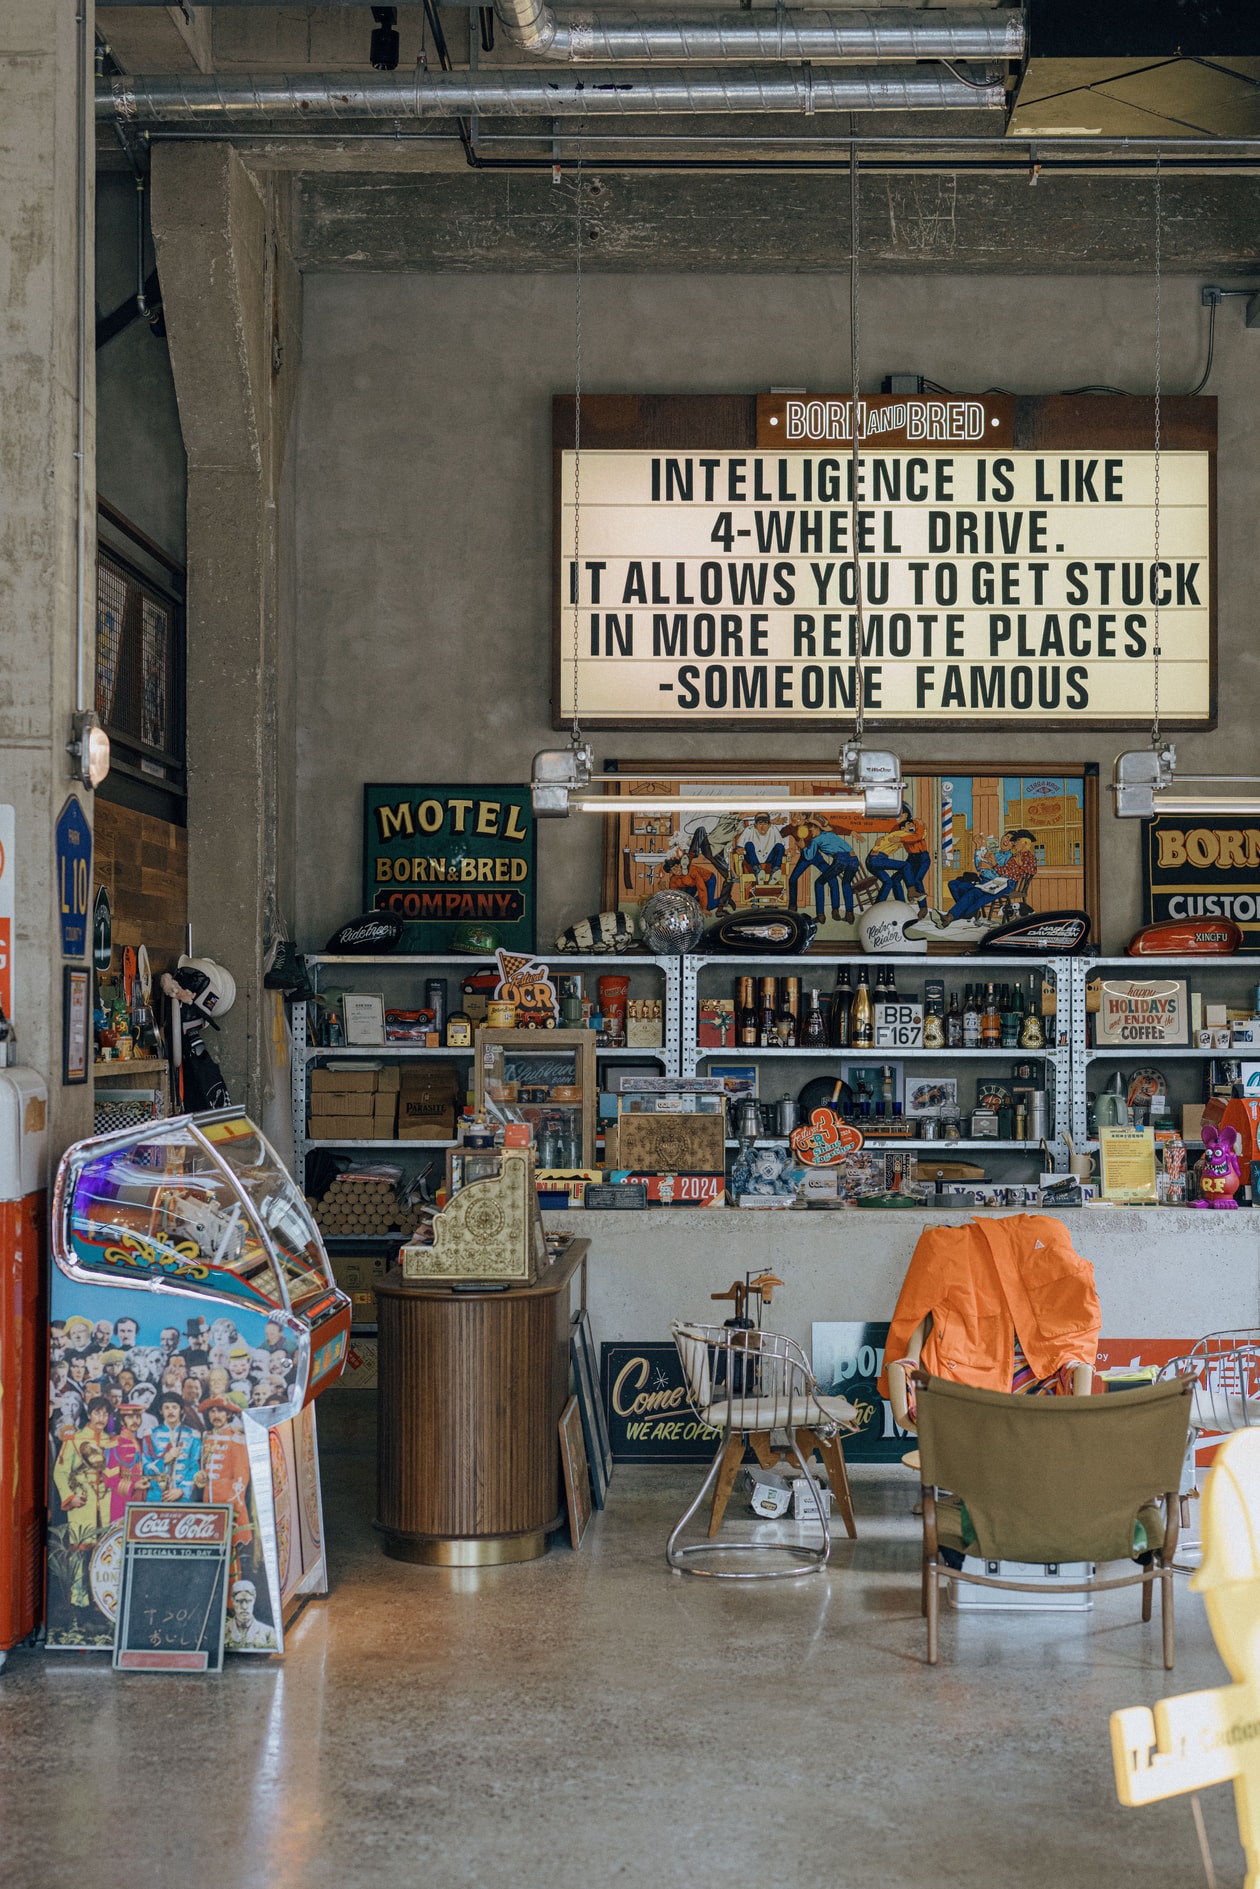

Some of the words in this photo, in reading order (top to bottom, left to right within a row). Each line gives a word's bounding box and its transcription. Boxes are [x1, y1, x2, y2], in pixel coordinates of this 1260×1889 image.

[787, 401, 867, 440] BORN
[867, 405, 906, 436] AND
[906, 401, 985, 440] BRED
[652, 458, 953, 502] INTELLIGENCE
[978, 458, 1014, 502] IS
[1036, 458, 1122, 502] LIKE
[711, 511, 901, 553] 4-WHEEL
[929, 511, 1063, 553] DRIVE.
[571, 561, 606, 605] IT
[623, 561, 795, 605] ALLOWS
[811, 561, 888, 605] YOU
[909, 561, 957, 605] TO
[973, 561, 1048, 605] GET
[1067, 561, 1200, 605] STUCK
[591, 613, 632, 657] IN
[653, 613, 768, 657] MORE
[794, 613, 960, 657] REMOTE
[990, 613, 1160, 657] PLACES.
[660, 665, 881, 709] -SOMEONE
[917, 665, 1088, 709] FAMOUS
[376, 799, 528, 841] MOTEL
[376, 857, 446, 882] BORN
[447, 866, 459, 882] &
[460, 857, 528, 882] BRED
[388, 893, 512, 917] COMPANY
[1168, 895, 1260, 920] CUSTO
[1195, 933, 1228, 942] XINGFU
[501, 983, 554, 1007] OCR
[1108, 999, 1177, 1014] HOLIDAYS
[884, 1006, 913, 1025] BB
[1124, 1014, 1163, 1025] ENJOY
[876, 1026, 922, 1046] F167
[1121, 1025, 1165, 1040] COFFEE
[811, 1107, 839, 1146] 3
[812, 1140, 842, 1157] Shine
[812, 1141, 855, 1165] Together
[681, 1178, 719, 1199] 2024
[612, 1357, 685, 1418] Come
[626, 1421, 653, 1440] WE
[650, 1421, 685, 1440] ARE
